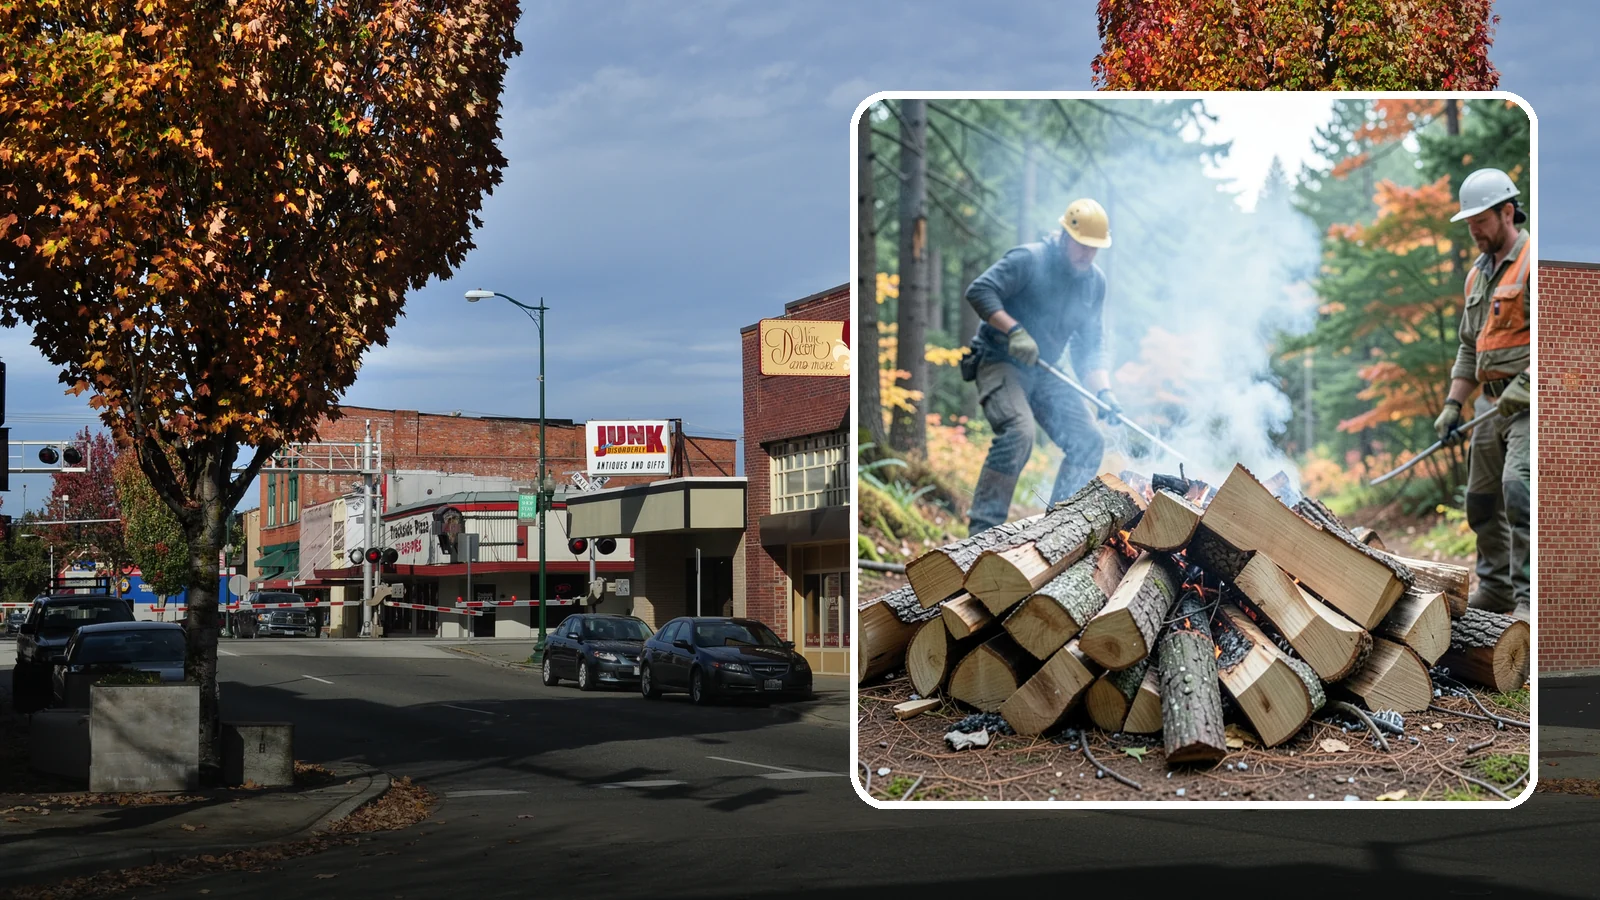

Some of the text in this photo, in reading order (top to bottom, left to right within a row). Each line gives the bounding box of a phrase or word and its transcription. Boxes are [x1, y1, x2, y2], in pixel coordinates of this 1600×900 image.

[596, 425, 664, 457] JUNK
[607, 446, 646, 454] DISORDERLY
[596, 460, 665, 470] ANTIQUES AND GIFTS
[390, 519, 429, 540] Trackside Pizza
